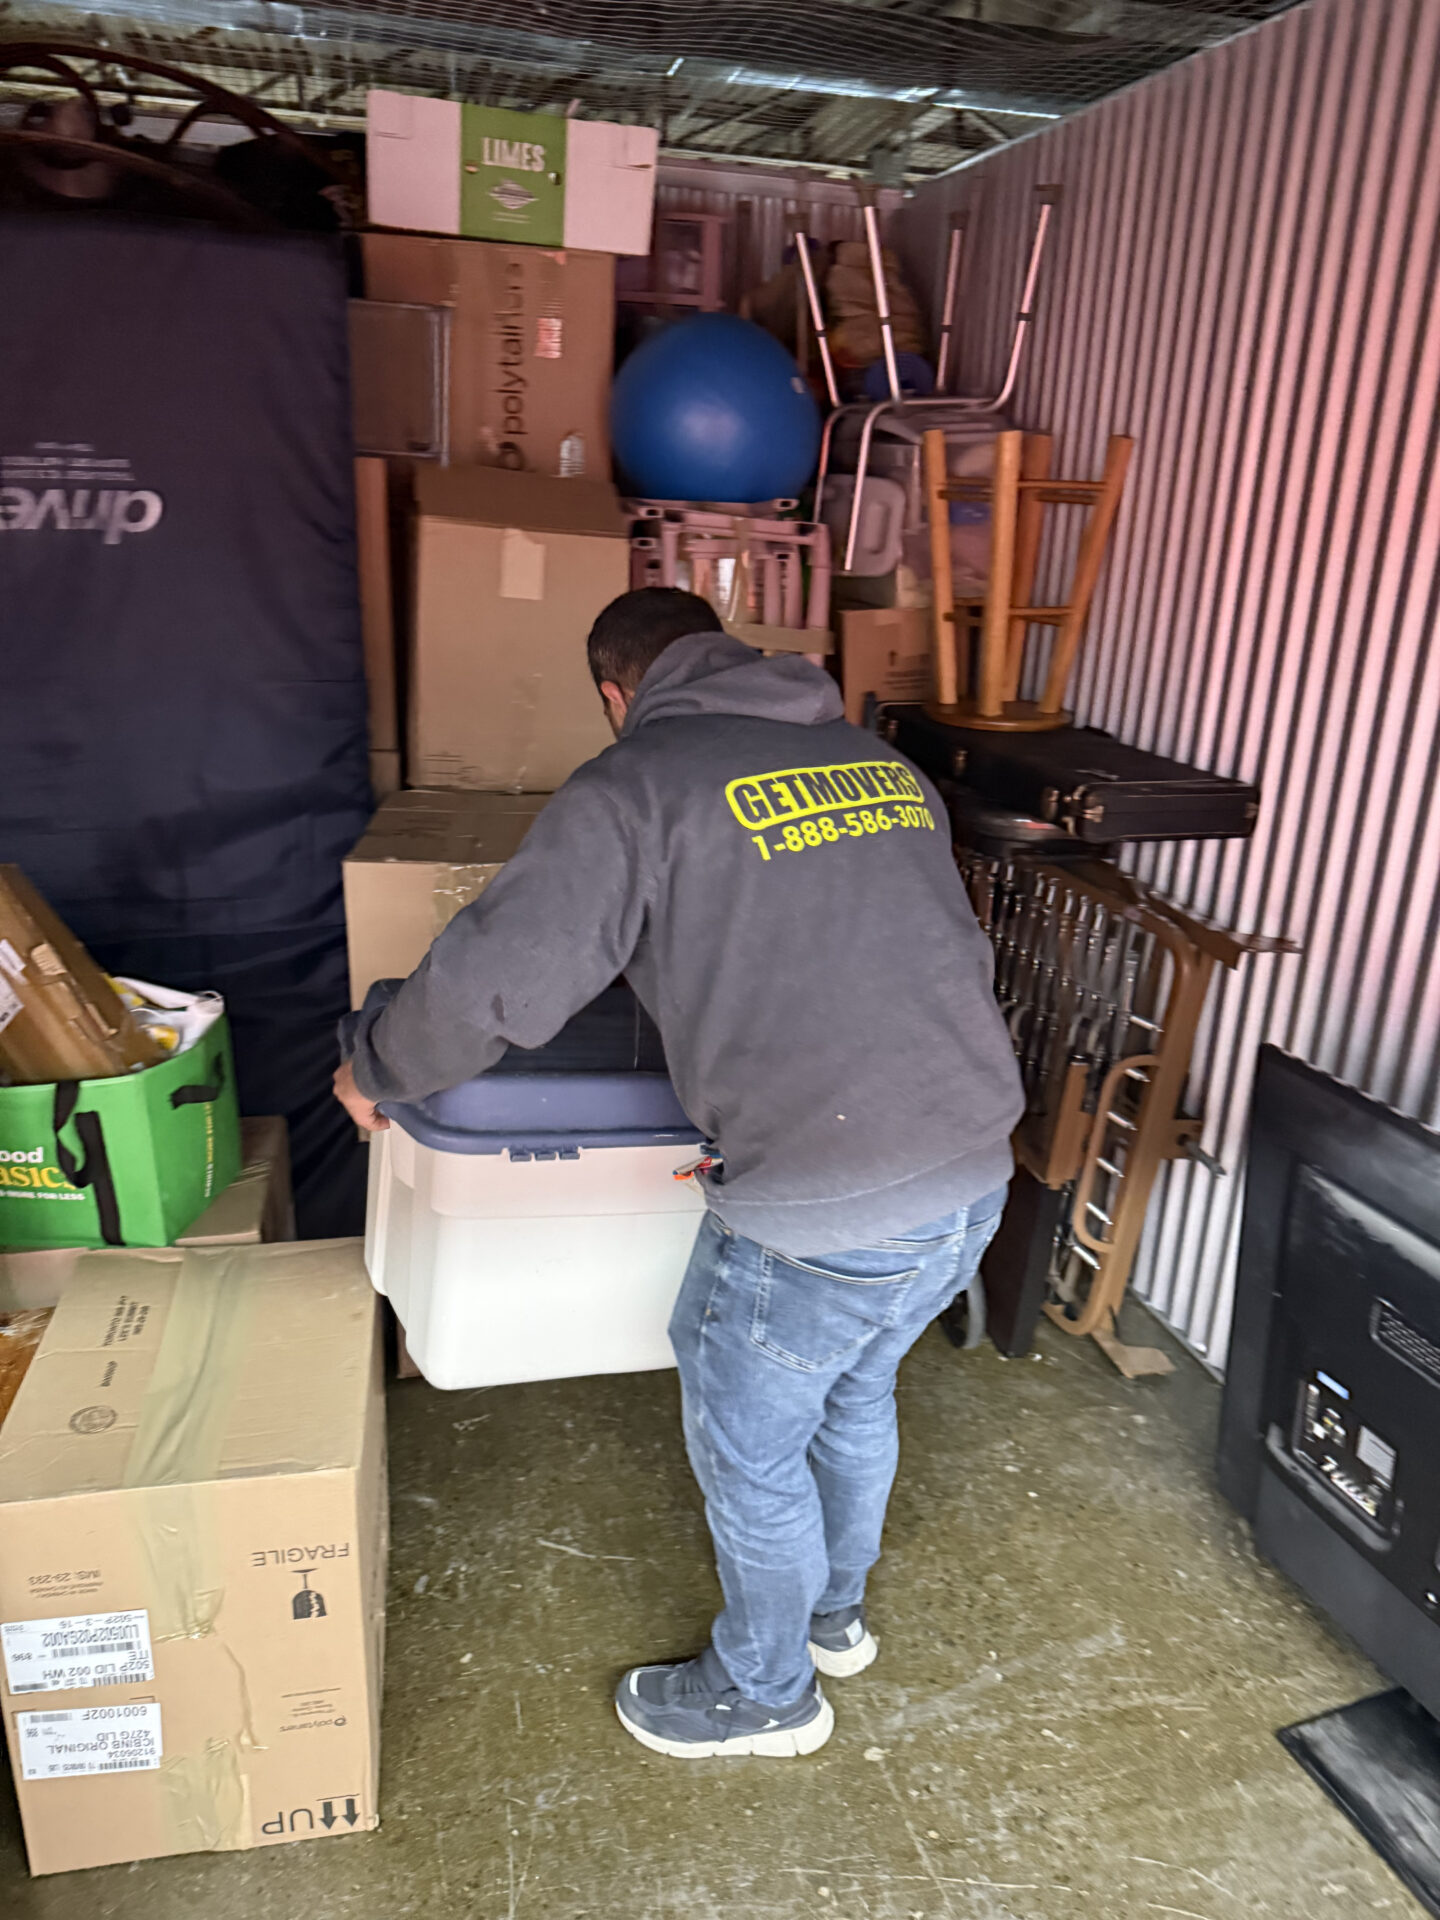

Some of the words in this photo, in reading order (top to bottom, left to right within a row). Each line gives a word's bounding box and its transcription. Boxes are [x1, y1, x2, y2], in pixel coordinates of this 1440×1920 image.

[481, 136, 545, 172] LIMES
[732, 763, 921, 826] GETMOVERS
[752, 804, 935, 861] 1-888-586-3070
[0, 1146, 44, 1163] ood
[0, 1166, 77, 1190] asic
[251, 1543, 350, 1568] FRAGILE
[94, 1663, 116, 1675] LID
[96, 1732, 116, 1742] LID
[119, 1729, 151, 1740] 427G
[46, 1741, 108, 1754] ORIGINAL
[261, 1808, 315, 1836] UP
